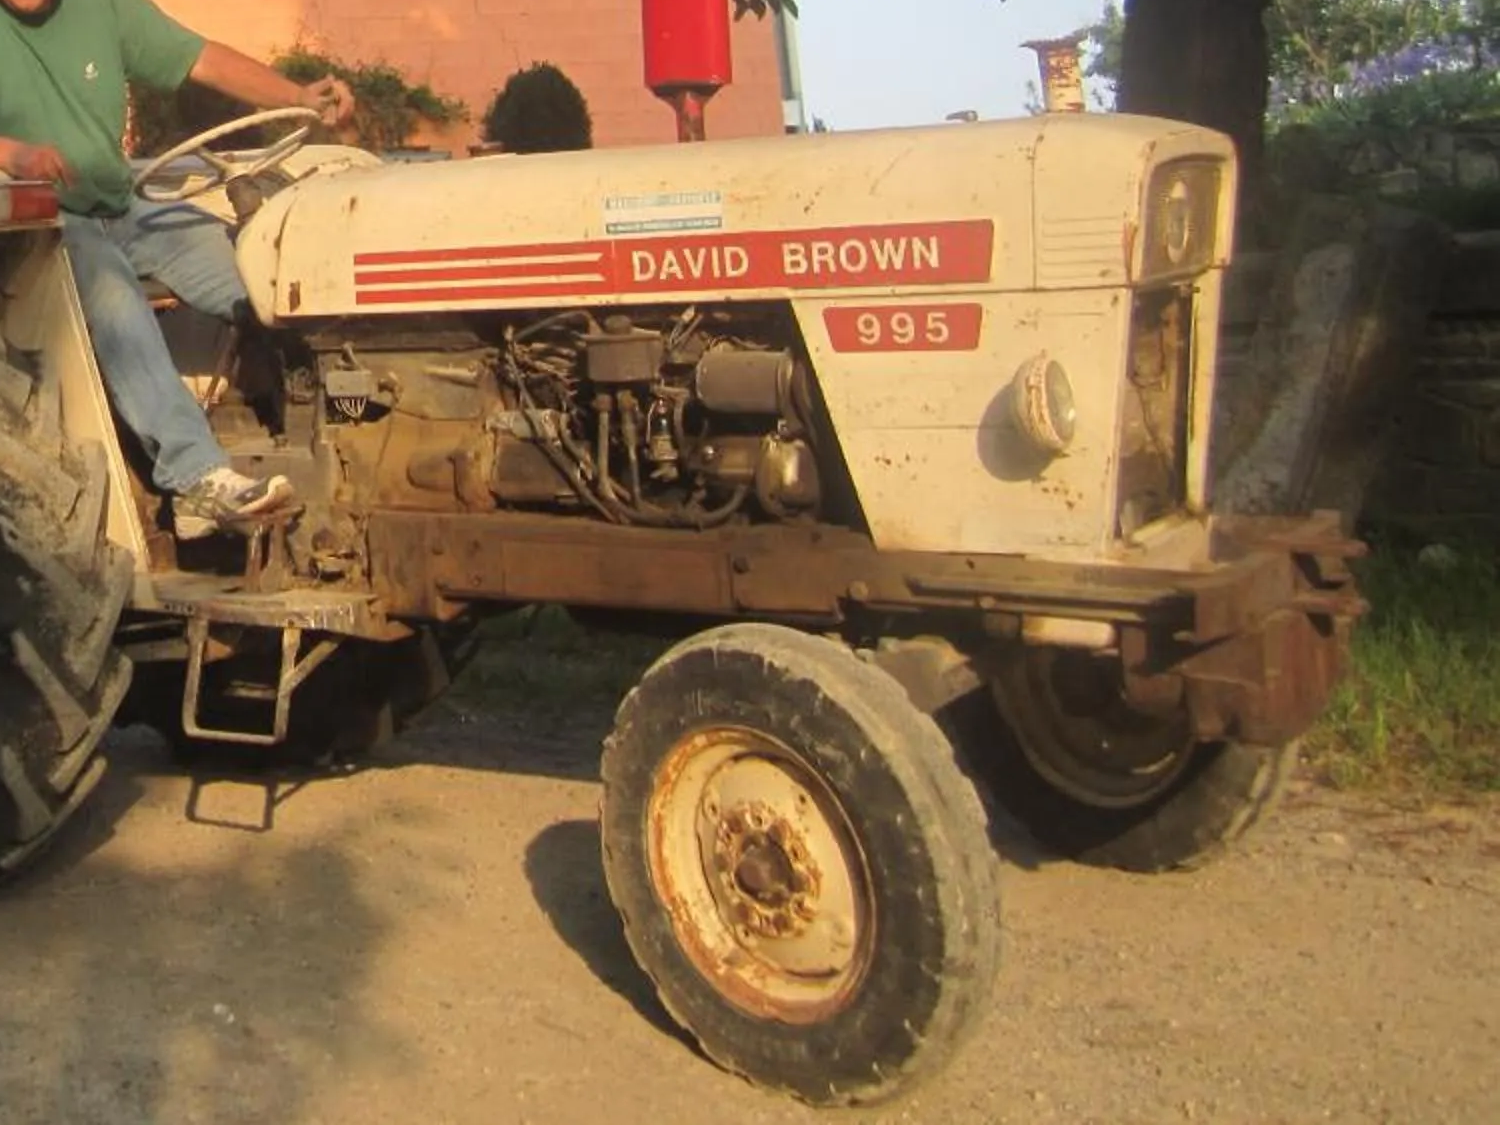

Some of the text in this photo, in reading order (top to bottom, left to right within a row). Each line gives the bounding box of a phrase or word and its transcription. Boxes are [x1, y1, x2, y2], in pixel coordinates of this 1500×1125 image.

[631, 235, 940, 282] DAVID BROWN
[856, 311, 950, 345] 995
